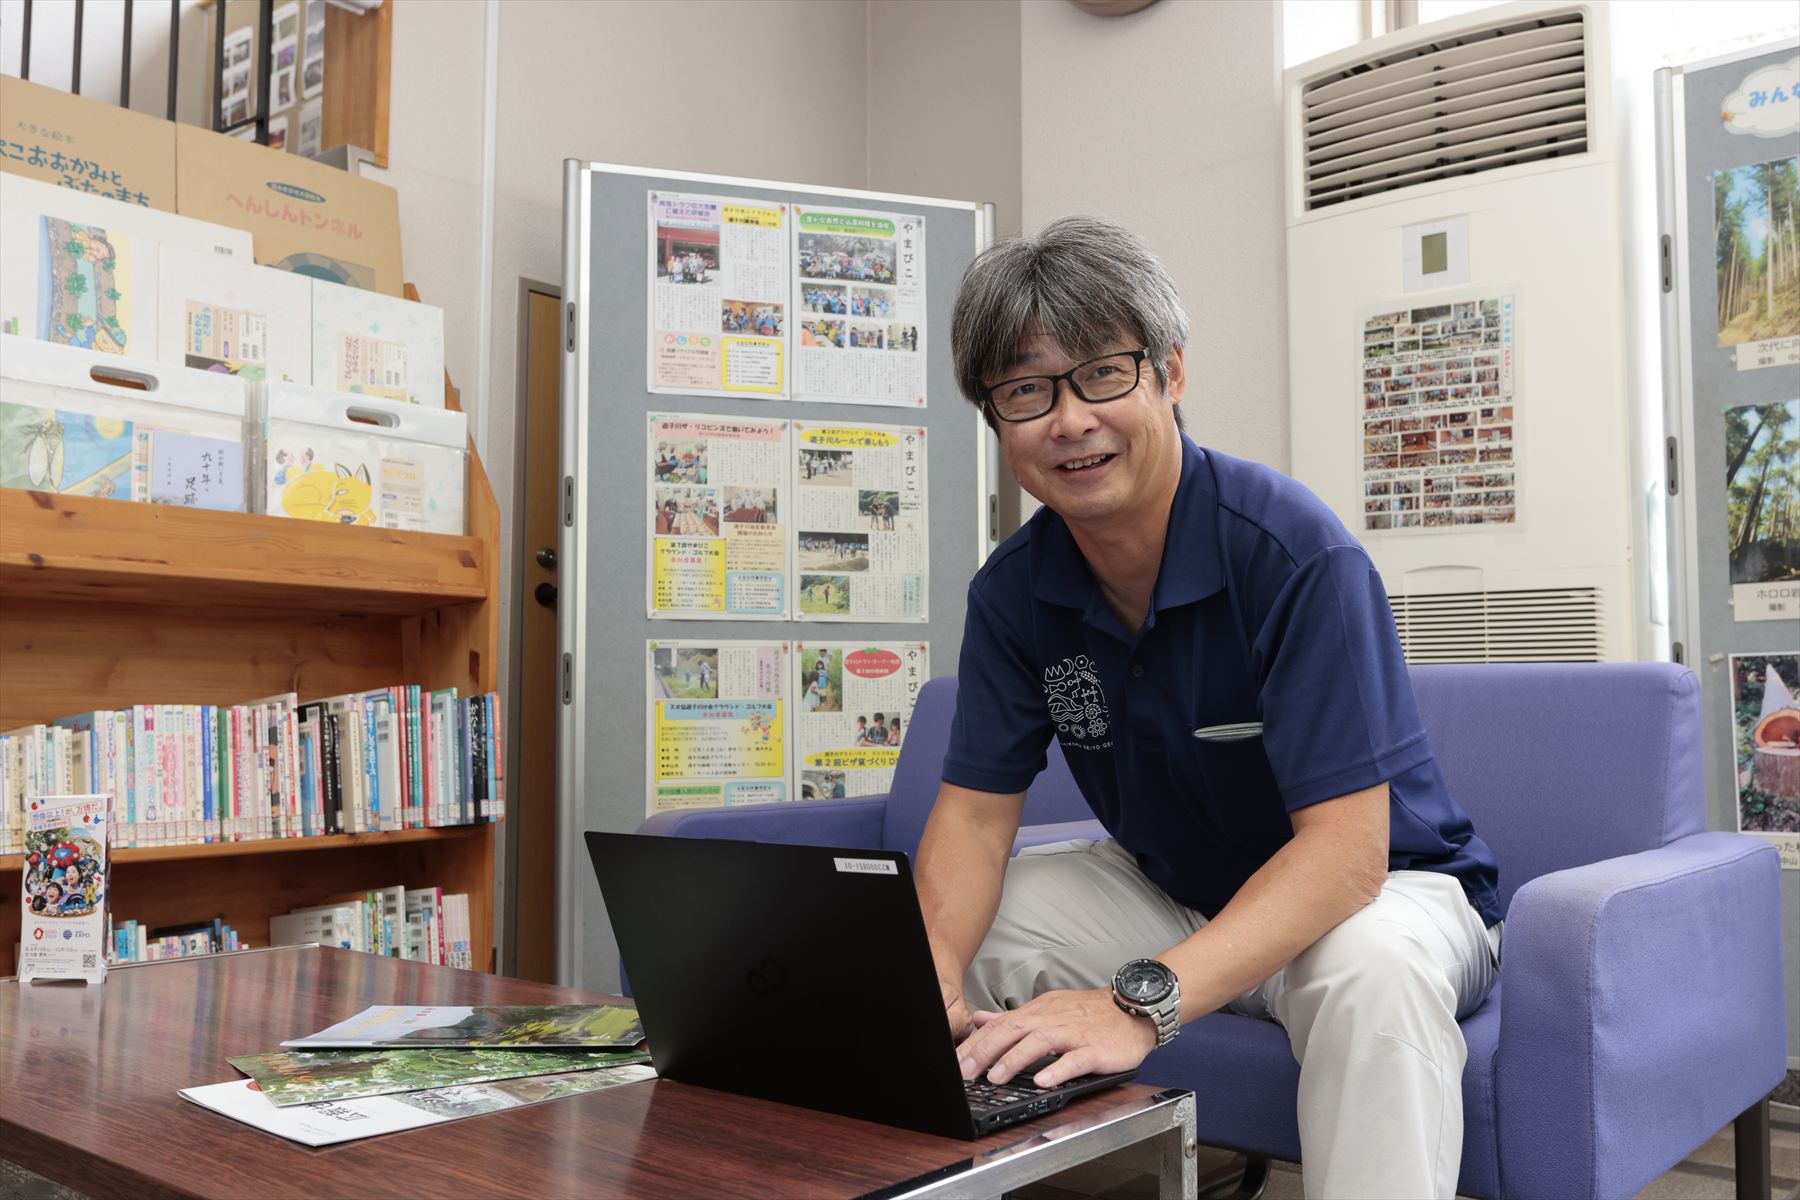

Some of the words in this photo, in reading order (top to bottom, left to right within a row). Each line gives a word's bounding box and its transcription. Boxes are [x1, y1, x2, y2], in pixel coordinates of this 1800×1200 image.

[225, 193, 363, 240] へんしんトンネル
[903, 223, 914, 279] やまびこ
[904, 435, 916, 491] やまびこ
